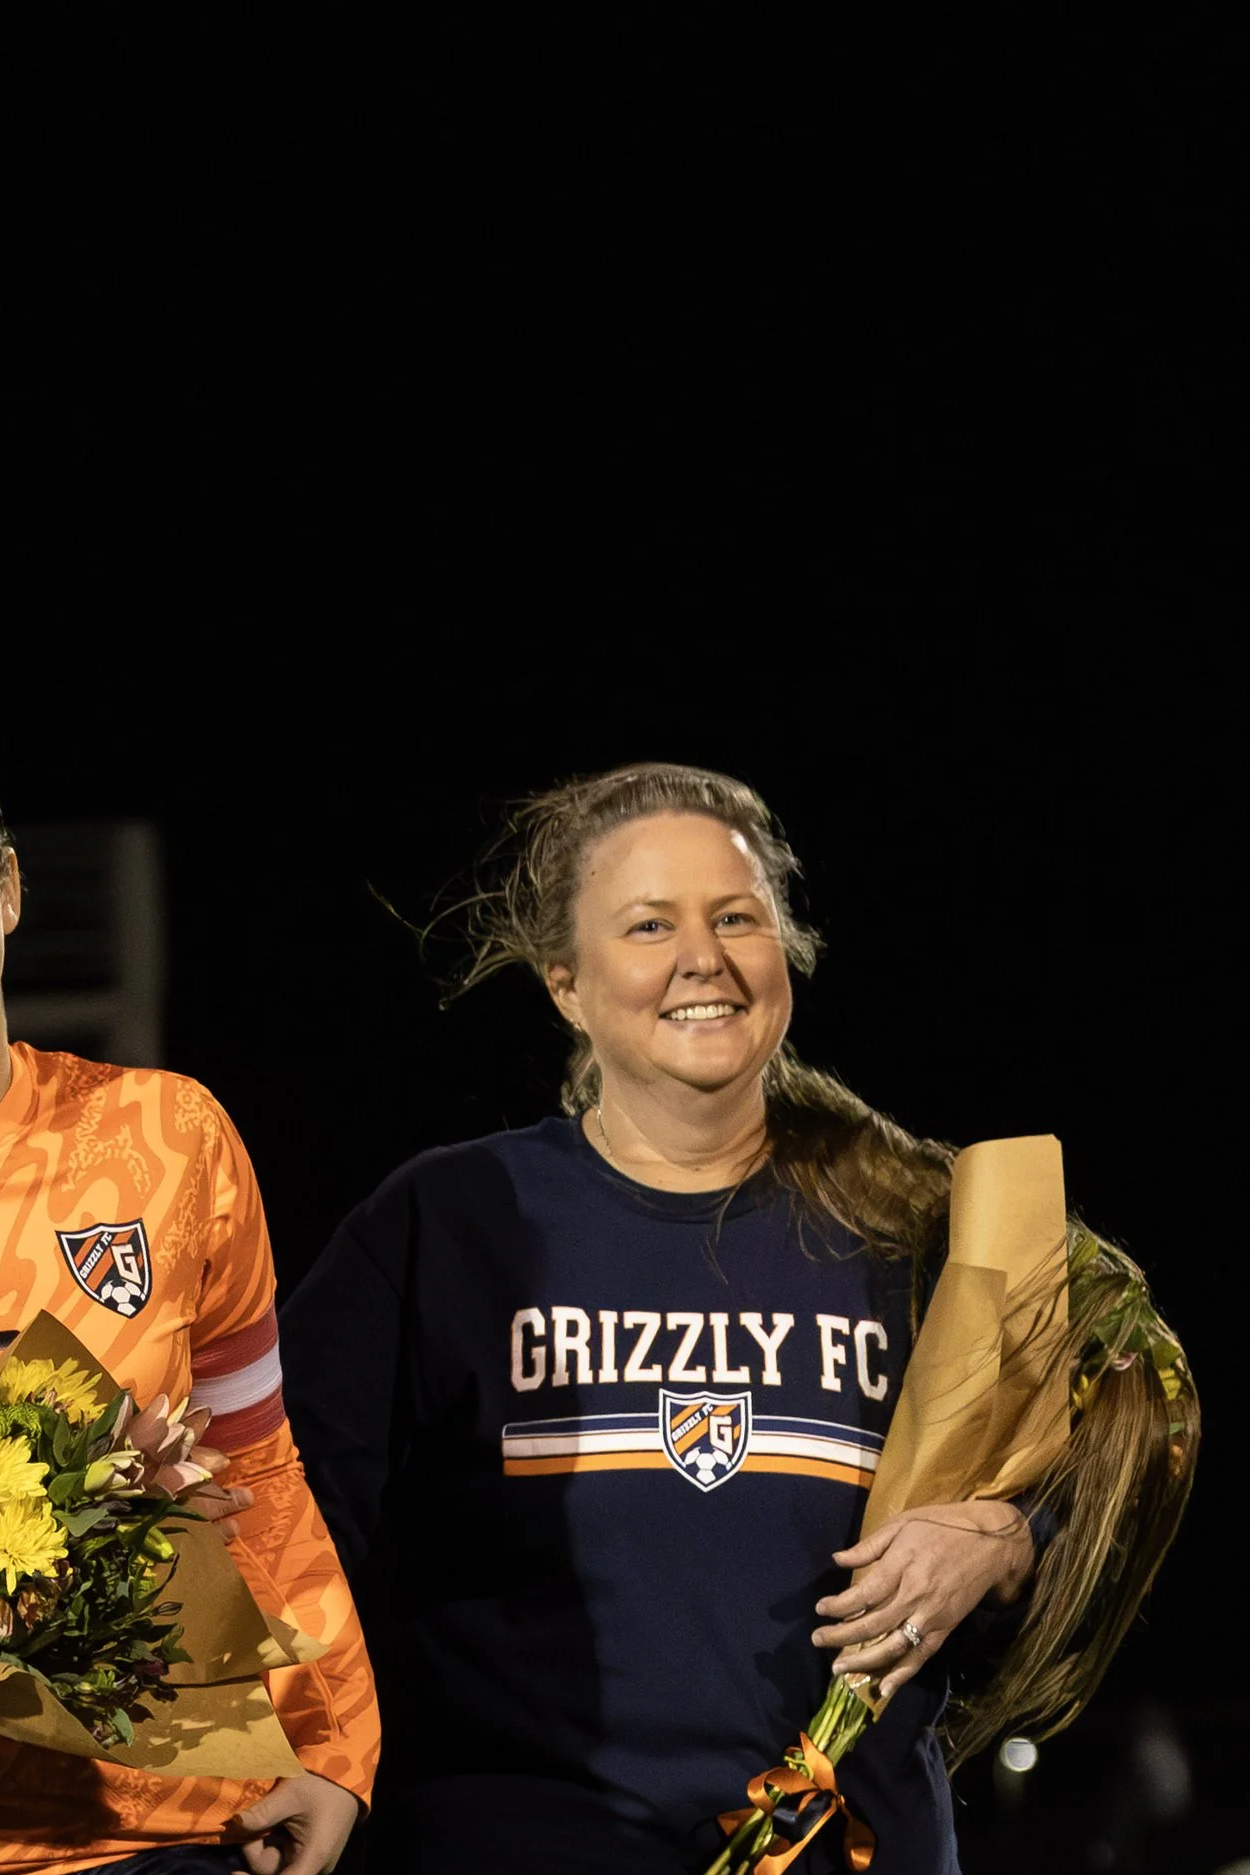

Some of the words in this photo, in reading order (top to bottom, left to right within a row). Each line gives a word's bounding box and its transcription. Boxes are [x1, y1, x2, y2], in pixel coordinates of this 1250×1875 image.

[79, 1243, 104, 1279] GRIZZLY
[100, 1232, 113, 1246] FC
[111, 1244, 143, 1286] G
[509, 1305, 795, 1393] GRIZZLY
[815, 1313, 889, 1401] FC
[710, 1415, 733, 1456] G
